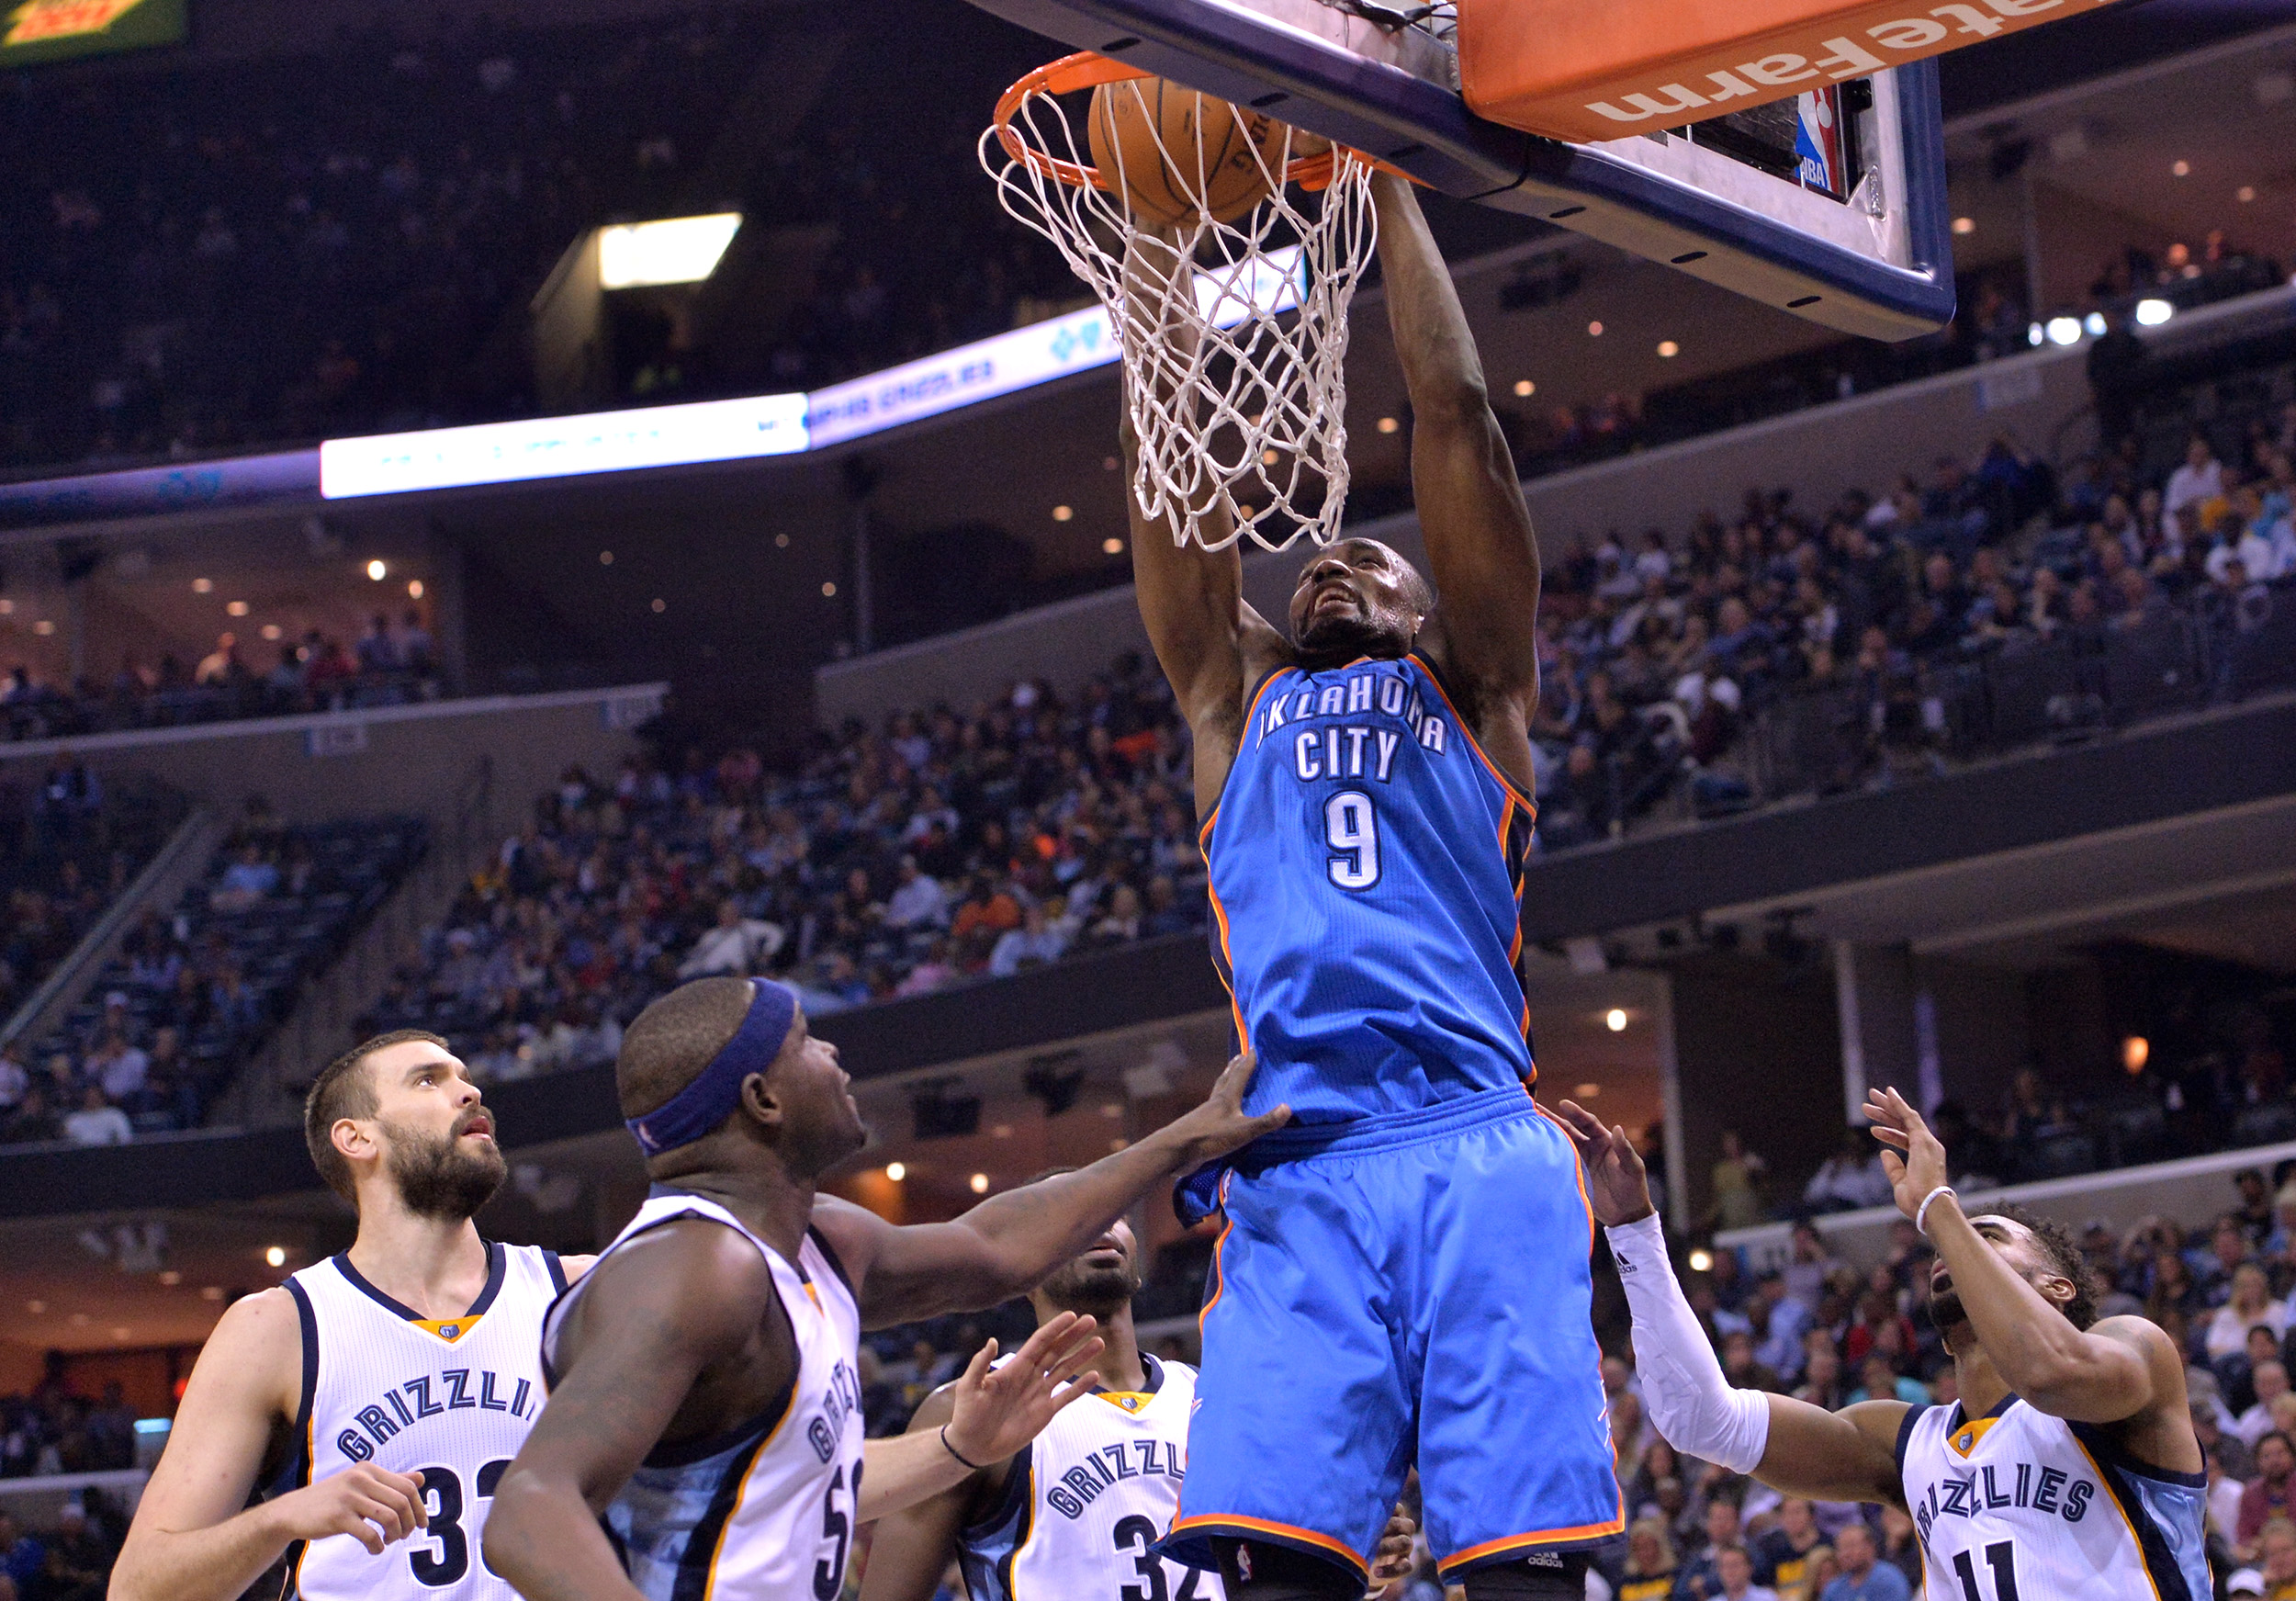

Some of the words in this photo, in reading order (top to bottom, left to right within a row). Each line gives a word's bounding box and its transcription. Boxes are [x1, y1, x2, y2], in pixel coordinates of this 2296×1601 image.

[1801, 156, 1826, 187] NBA
[1294, 724, 1403, 784] CITY
[1323, 790, 1382, 893] 9
[337, 1369, 535, 1463] GRIZZLI
[409, 1459, 516, 1587] 3
[813, 1458, 863, 1601] 5
[1528, 1556, 1564, 1569] adidas
